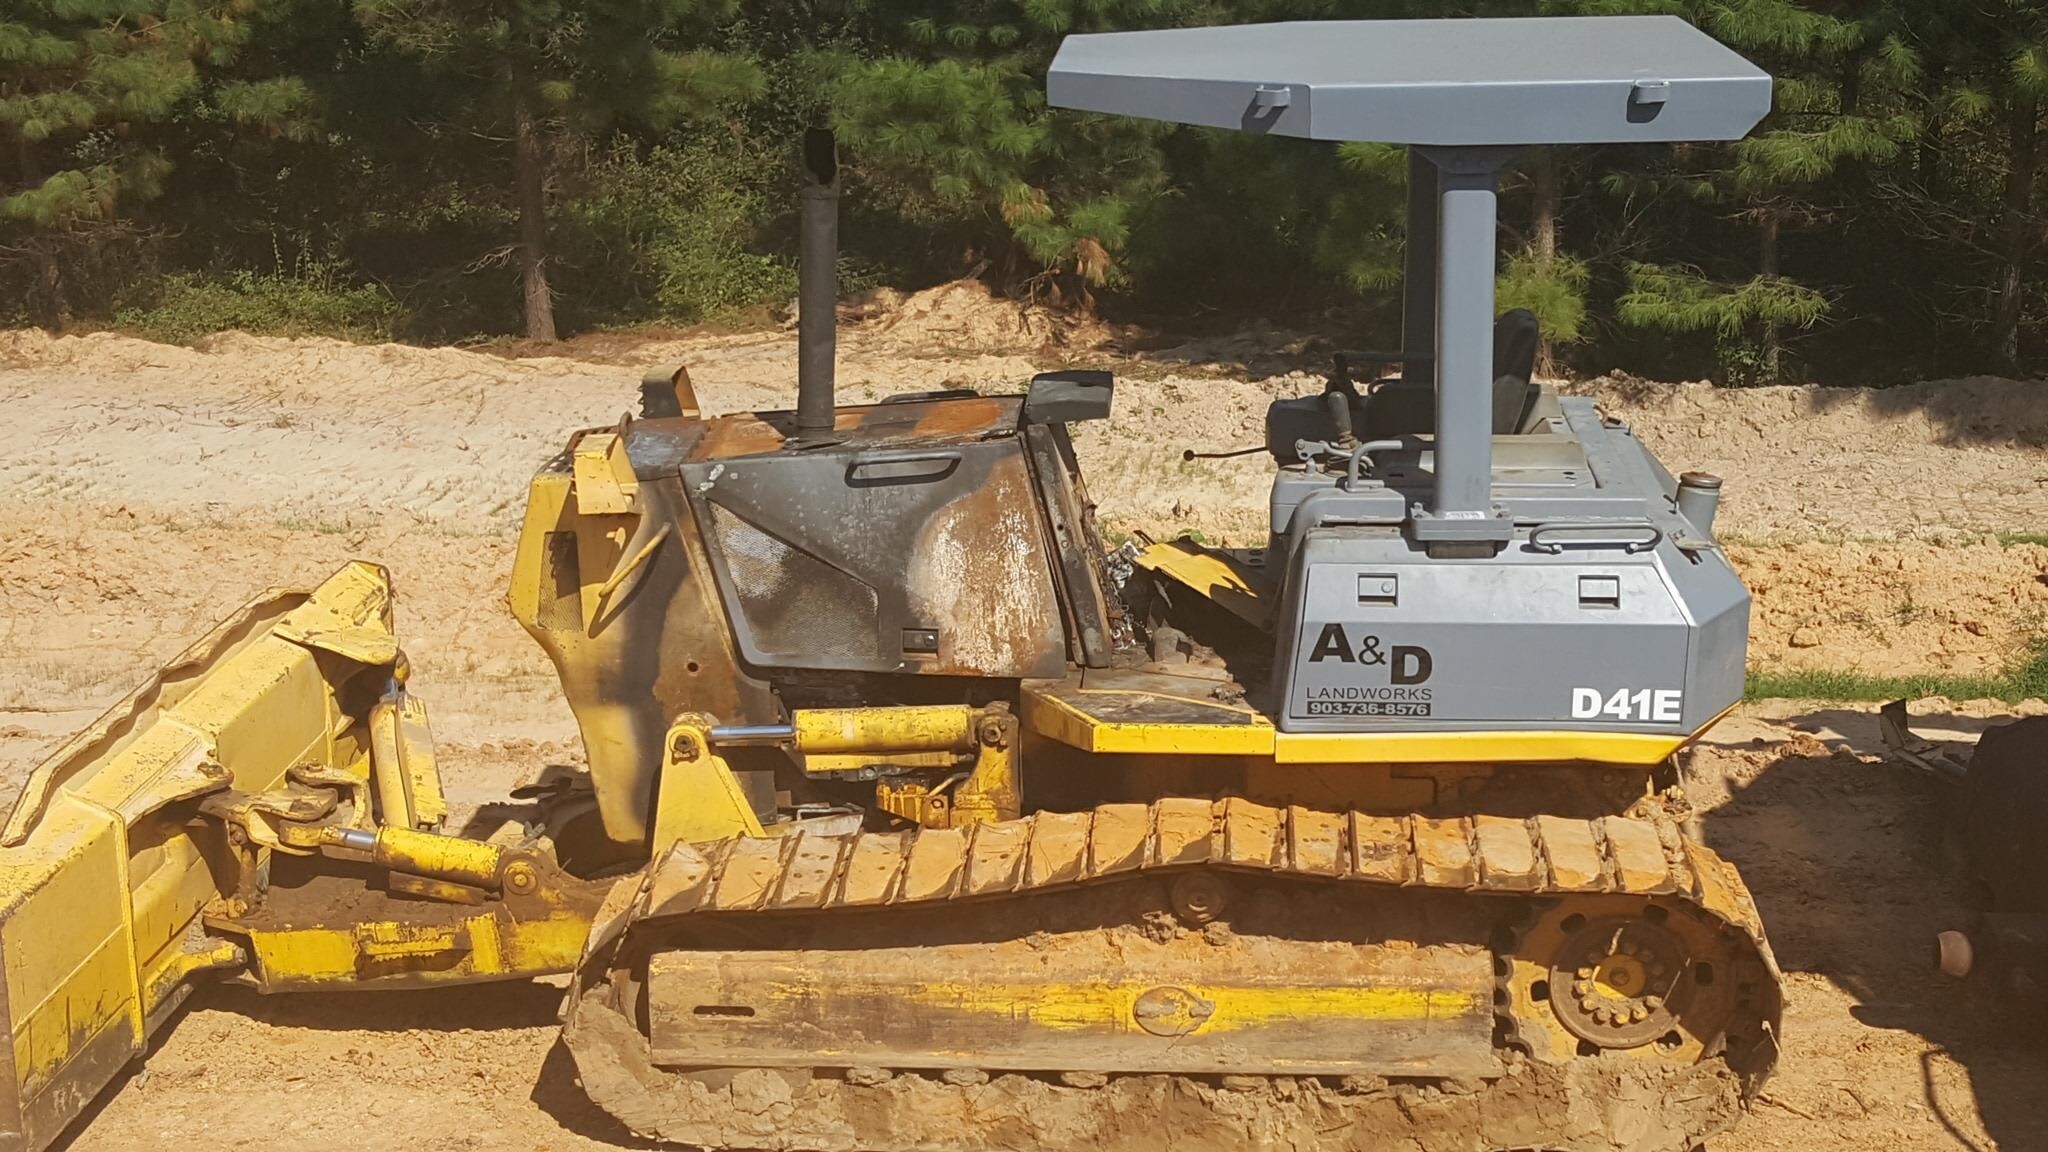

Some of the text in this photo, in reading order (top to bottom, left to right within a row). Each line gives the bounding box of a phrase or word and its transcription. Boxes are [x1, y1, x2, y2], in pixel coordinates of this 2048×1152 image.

[1308, 623, 1433, 685] A&D
[1307, 687, 1432, 701] LANDWORKS
[1572, 688, 1681, 720] D41E
[1310, 702, 1428, 715] 903-736-8576
